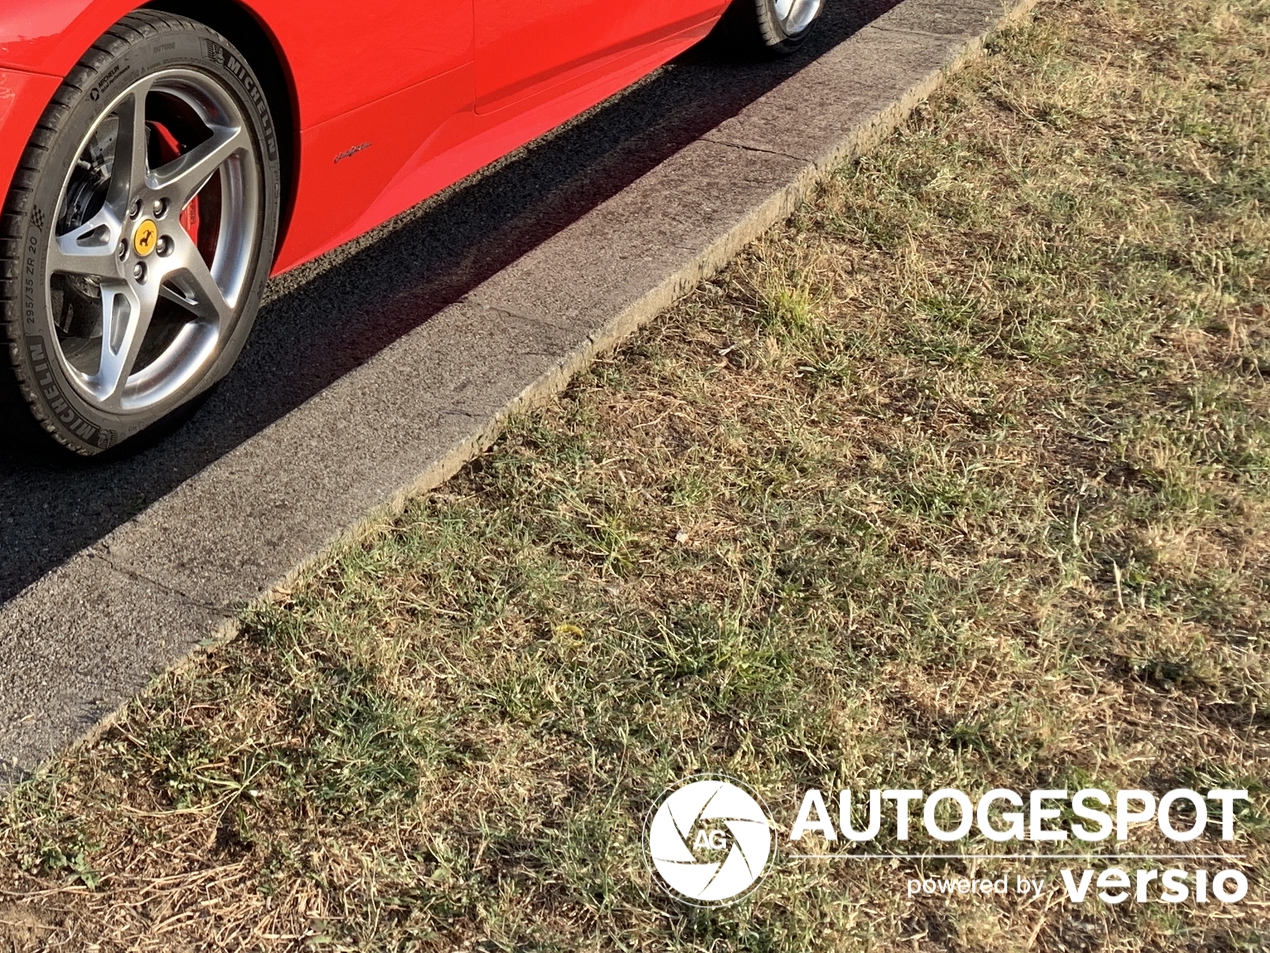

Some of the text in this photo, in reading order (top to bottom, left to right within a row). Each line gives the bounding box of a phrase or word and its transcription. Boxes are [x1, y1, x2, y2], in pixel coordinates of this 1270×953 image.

[98, 64, 120, 89] MICHELIN
[228, 55, 277, 152] MICHELIN
[25, 236, 38, 324] 295/35 ZR 20
[30, 343, 99, 442] MICHELIN
